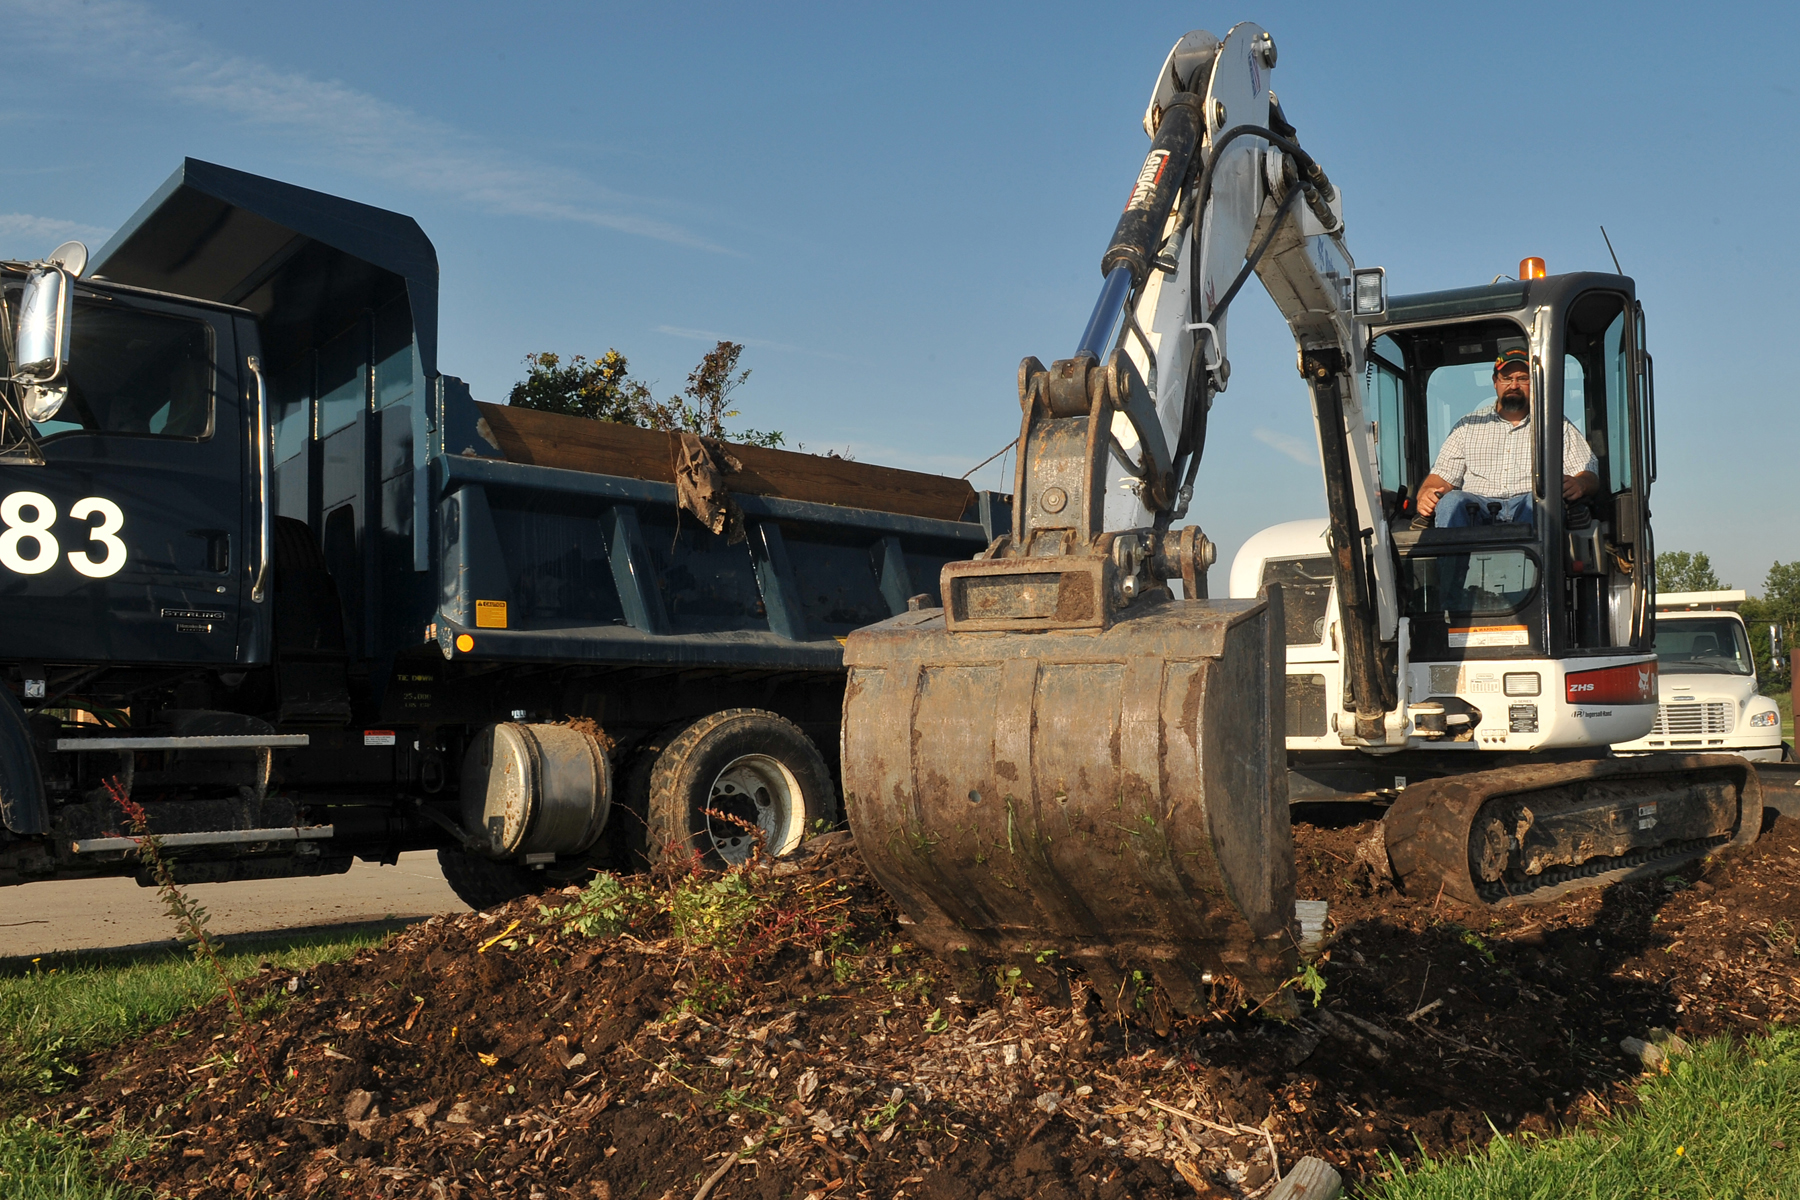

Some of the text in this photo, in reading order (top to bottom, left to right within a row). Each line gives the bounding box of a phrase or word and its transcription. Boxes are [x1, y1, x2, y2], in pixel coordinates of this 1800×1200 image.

[0, 490, 128, 578] 83
[164, 610, 222, 619] STERLING
[411, 674, 433, 682] DOWN
[1569, 683, 1595, 692] ZHS
